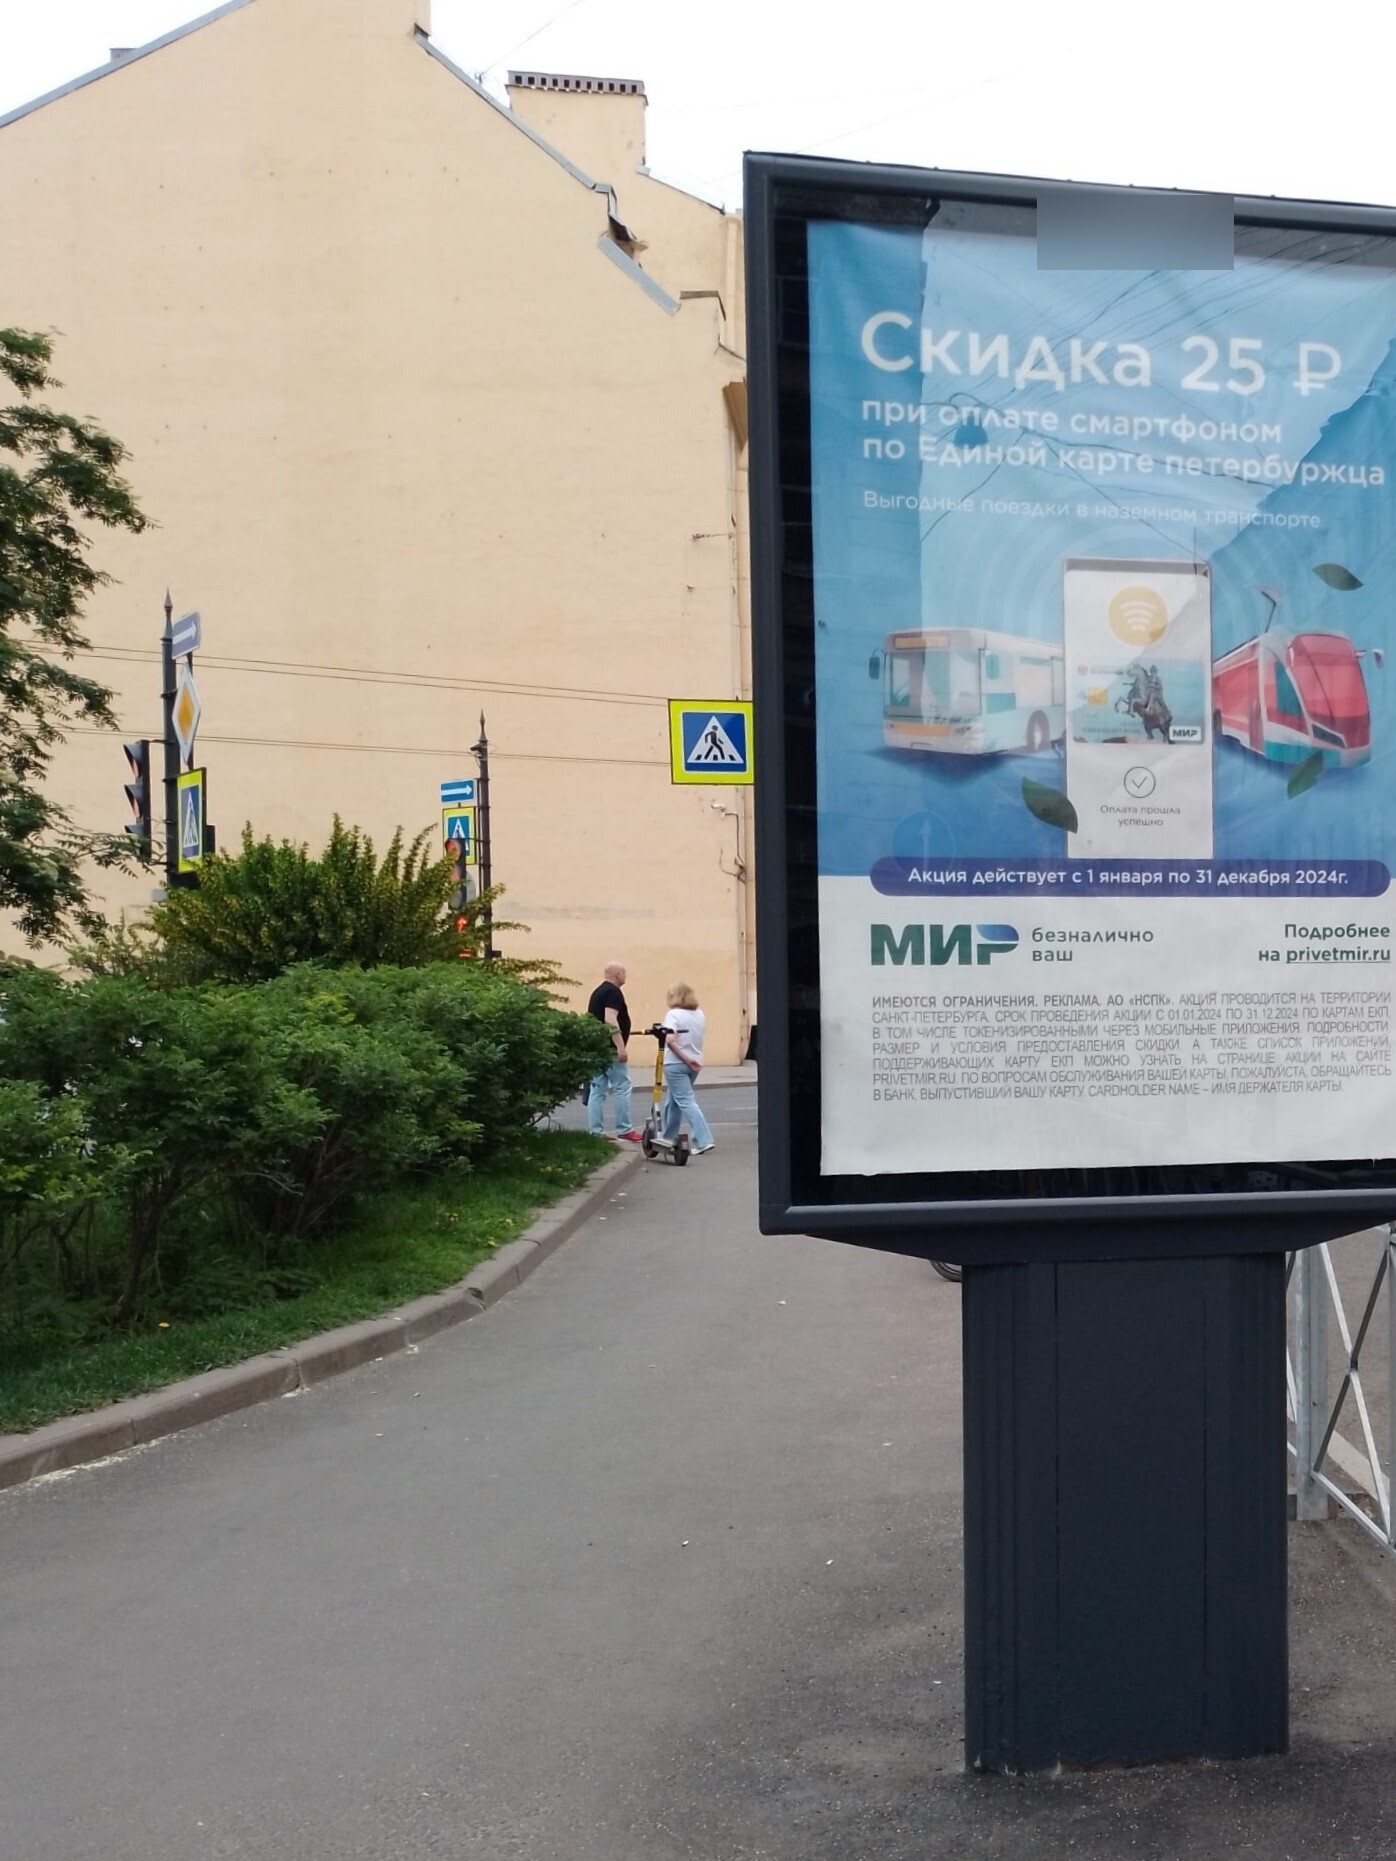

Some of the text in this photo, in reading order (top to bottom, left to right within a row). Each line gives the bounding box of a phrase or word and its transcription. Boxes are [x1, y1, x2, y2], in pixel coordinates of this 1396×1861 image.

[861, 311, 1151, 393] Скидка
[1181, 335, 1266, 395] 25
[862, 400, 1282, 444] при оплате смартфоном
[863, 435, 1385, 488] по Единой карте петербуржца
[864, 491, 1321, 529] Выгодные поездки в наземном транспорте
[1172, 729, 1198, 738] МИР
[1100, 804, 1181, 816] Оплата прошла
[1118, 818, 1164, 827] успешно
[908, 867, 1348, 886] Акция действует с 1 января по 31 декабря 2024г.
[1032, 927, 1154, 943] безналично
[1284, 924, 1391, 941] Подробнее
[870, 924, 1019, 966] МИР
[1032, 950, 1073, 962] ваш
[1259, 947, 1391, 963] на privetmir.ru
[872, 996, 937, 1008] ИМЕЮТСЯ
[942, 996, 1038, 1007] ОГРАНИЧЕНИЯ.
[1107, 994, 1124, 1006] АО
[1129, 994, 1174, 1006] «НСПК».
[1179, 993, 1217, 1008] АКЦИЯ
[1222, 993, 1296, 1006] ПРОВОДИТСЯ
[1301, 993, 1315, 1004] НА
[1321, 992, 1391, 1003] ТЕРРИТОРИИ
[995, 1011, 1026, 1022] СРОК
[1031, 1010, 1109, 1023] ПРОВЕДЕНИЯ
[1113, 1010, 1151, 1023] АКЦИИ
[1156, 1009, 1164, 1021] С
[1226, 1008, 1242, 1019] ПО
[1302, 1008, 1318, 1018] ПО
[1322, 1006, 1364, 1018] КАРТАМ
[873, 1027, 880, 1039] В
[887, 1027, 912, 1039] ТОМ
[917, 1027, 957, 1039] ЧИСЛЕ
[964, 1025, 1098, 1038] ТОКЕНИЗИРОВАННЫМИ
[1103, 1024, 1139, 1036] ЧЕРЕЗ
[1145, 1023, 1216, 1036] МОБИЛЬНЫЕ
[873, 1042, 920, 1055] РАЗМЕР
[931, 1042, 939, 1054] И
[951, 1041, 1006, 1054] УСЛОВИЯ
[1017, 1039, 1125, 1053] ПРЕДОСТАВЛЕНИЯ
[1192, 1038, 1200, 1050] А
[1211, 1037, 1247, 1050] ТАКЖЕ
[1258, 1036, 1302, 1049] СПИСОК
[873, 1048, 1392, 1071] ПОДДЕРЖИВАЮЩИХ КАРТУ ЕКП МОЖНО УЗНАТЬ НА СТРАНИЦЕ АКЦИИ НА САЙТЕ
[962, 1072, 979, 1084] ПО
[982, 1071, 1046, 1083] ВОПРОСАМ
[1049, 1069, 1144, 1082] ОБСЛУЖИВАНИЯ
[1148, 1067, 1187, 1080] ВАШЕЙ
[1311, 1064, 1392, 1078] ОБРАЩАЙТЕСЬ
[874, 1088, 881, 1101] В
[920, 1085, 1012, 1100] ВЫПУСТИВШИЙ
[1014, 1087, 1047, 1098] ВАШУ
[1088, 1084, 1166, 1097] CARDHOLDER
[1168, 1083, 1200, 1095] NAME
[1212, 1081, 1236, 1094] ИМЯ
[1238, 1080, 1304, 1095] ДЕРЖАТЕЛЯ
